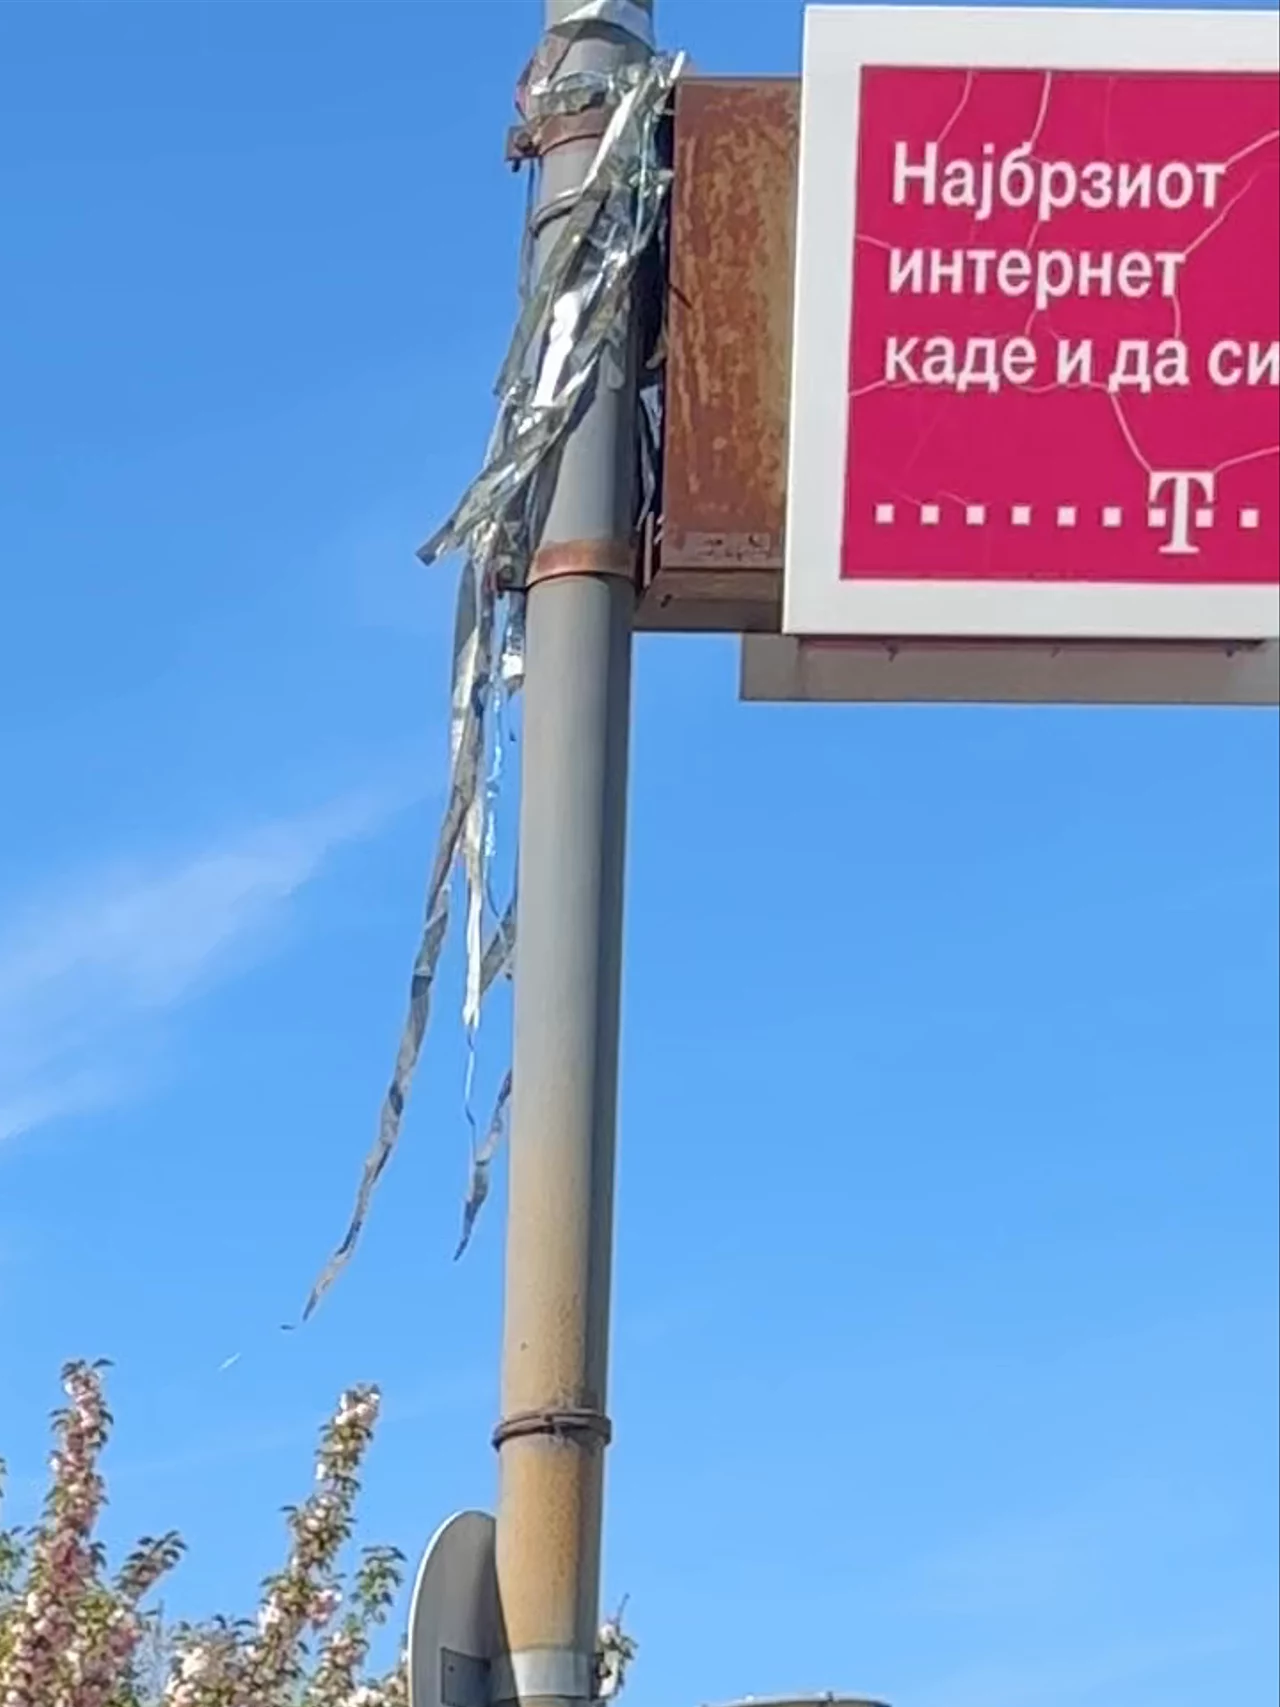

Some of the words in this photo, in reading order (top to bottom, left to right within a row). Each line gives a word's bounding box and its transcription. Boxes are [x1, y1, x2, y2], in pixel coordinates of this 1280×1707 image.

[893, 141, 1226, 221] Најбрзиот
[889, 248, 1187, 310] интернет
[885, 336, 1037, 392] каде
[1056, 339, 1092, 384] и
[1107, 339, 1190, 393] да
[1208, 340, 1280, 386] си
[1148, 471, 1215, 554] T
